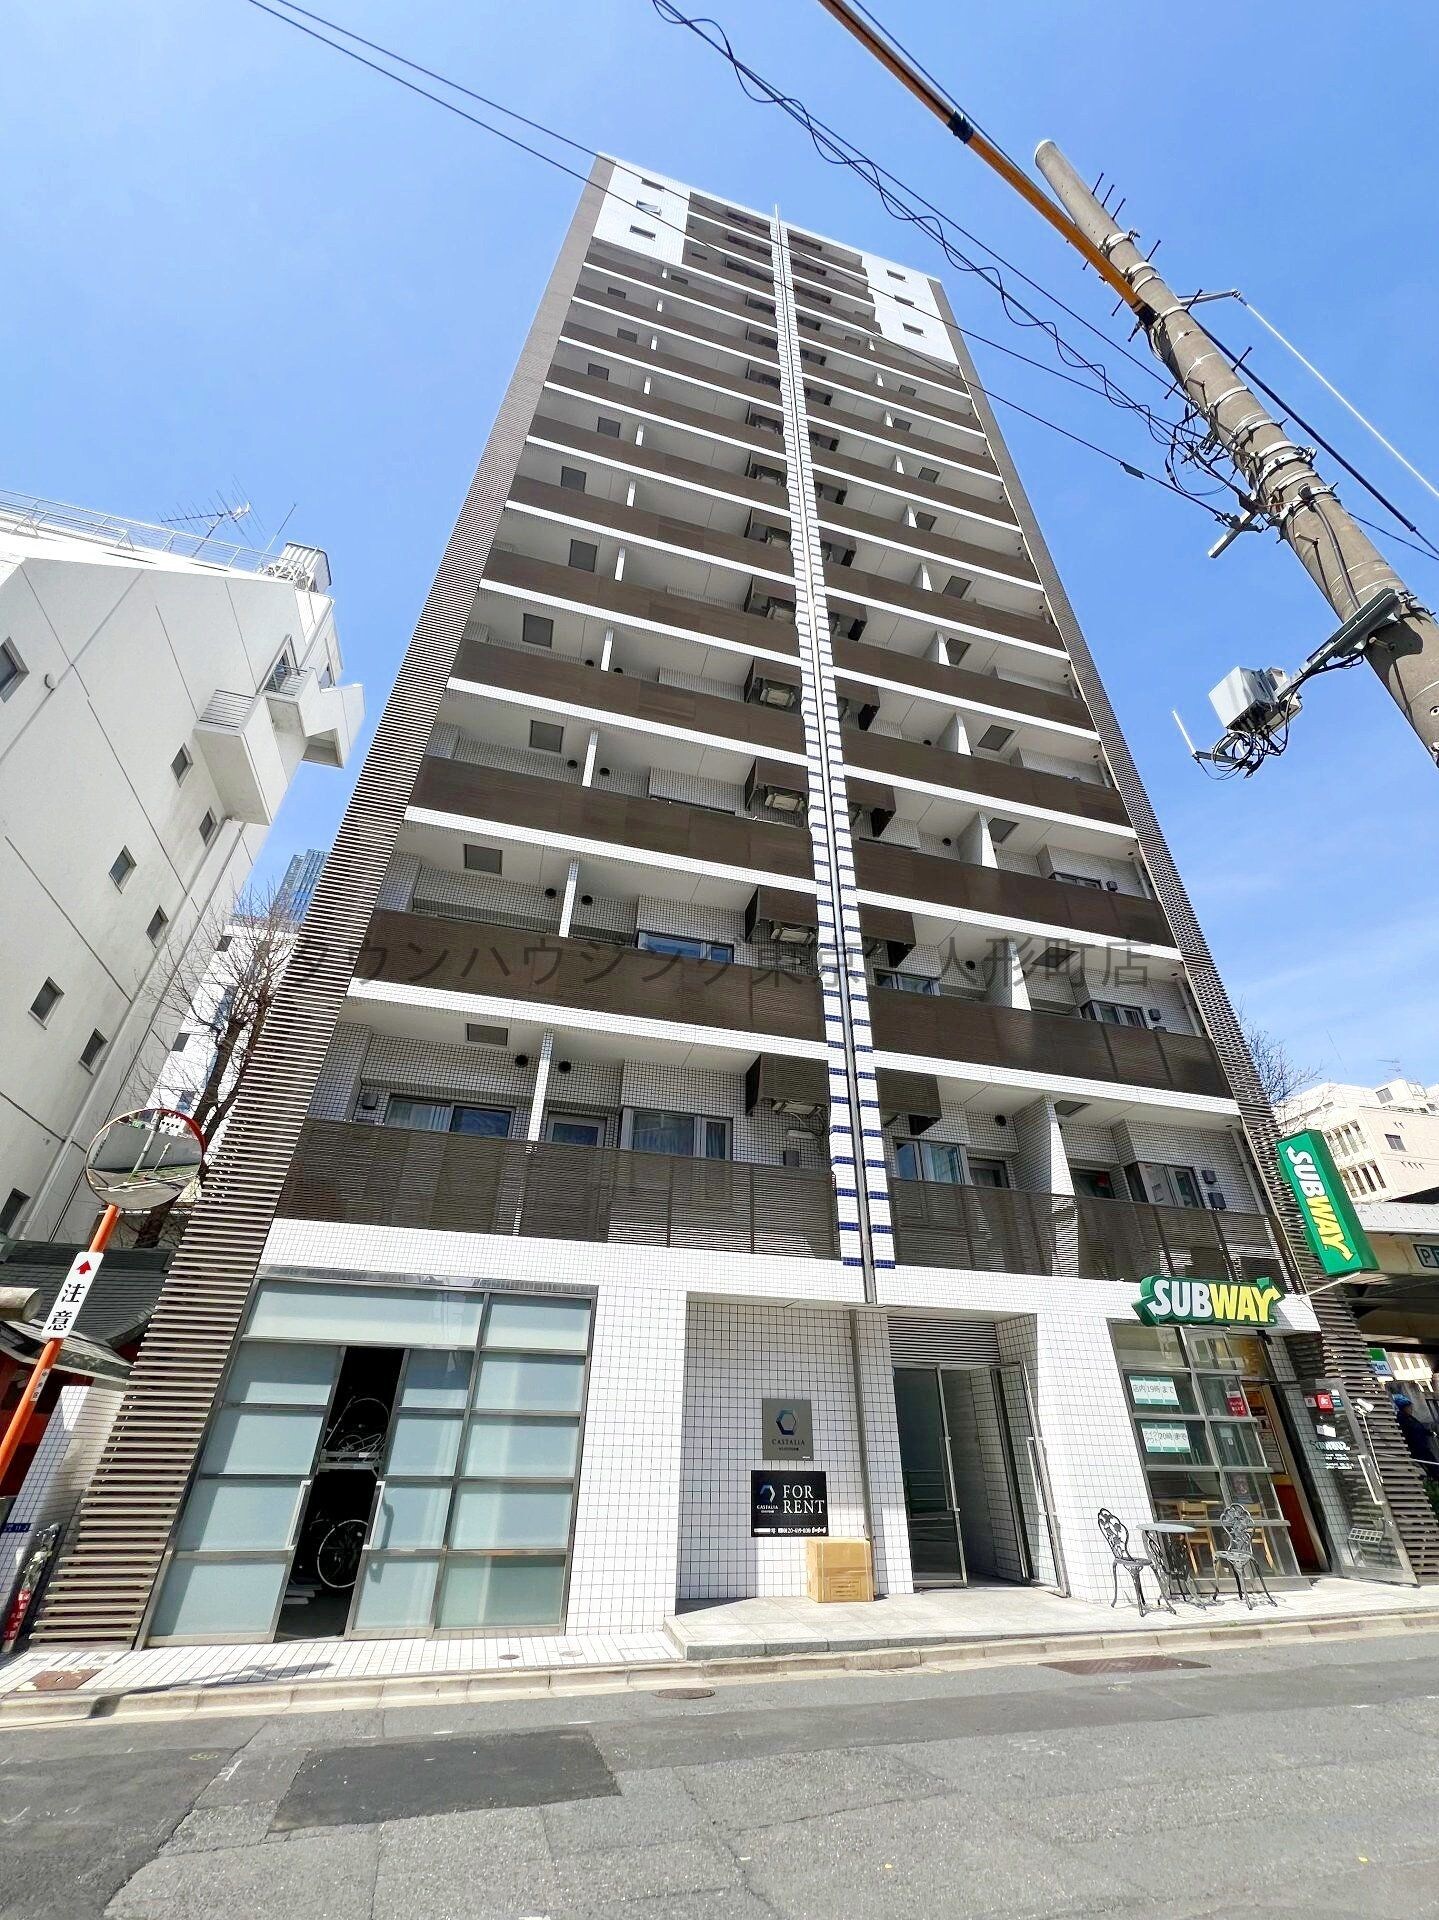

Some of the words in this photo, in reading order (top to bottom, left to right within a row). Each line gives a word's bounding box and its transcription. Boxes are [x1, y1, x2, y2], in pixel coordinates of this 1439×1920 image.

[1287, 1145, 1354, 1261] SUBWAY
[47, 1283, 86, 1331] 注意
[1147, 1279, 1282, 1323] SUBWAY
[783, 1485, 814, 1499] FOR
[783, 1499, 825, 1514] RENT
